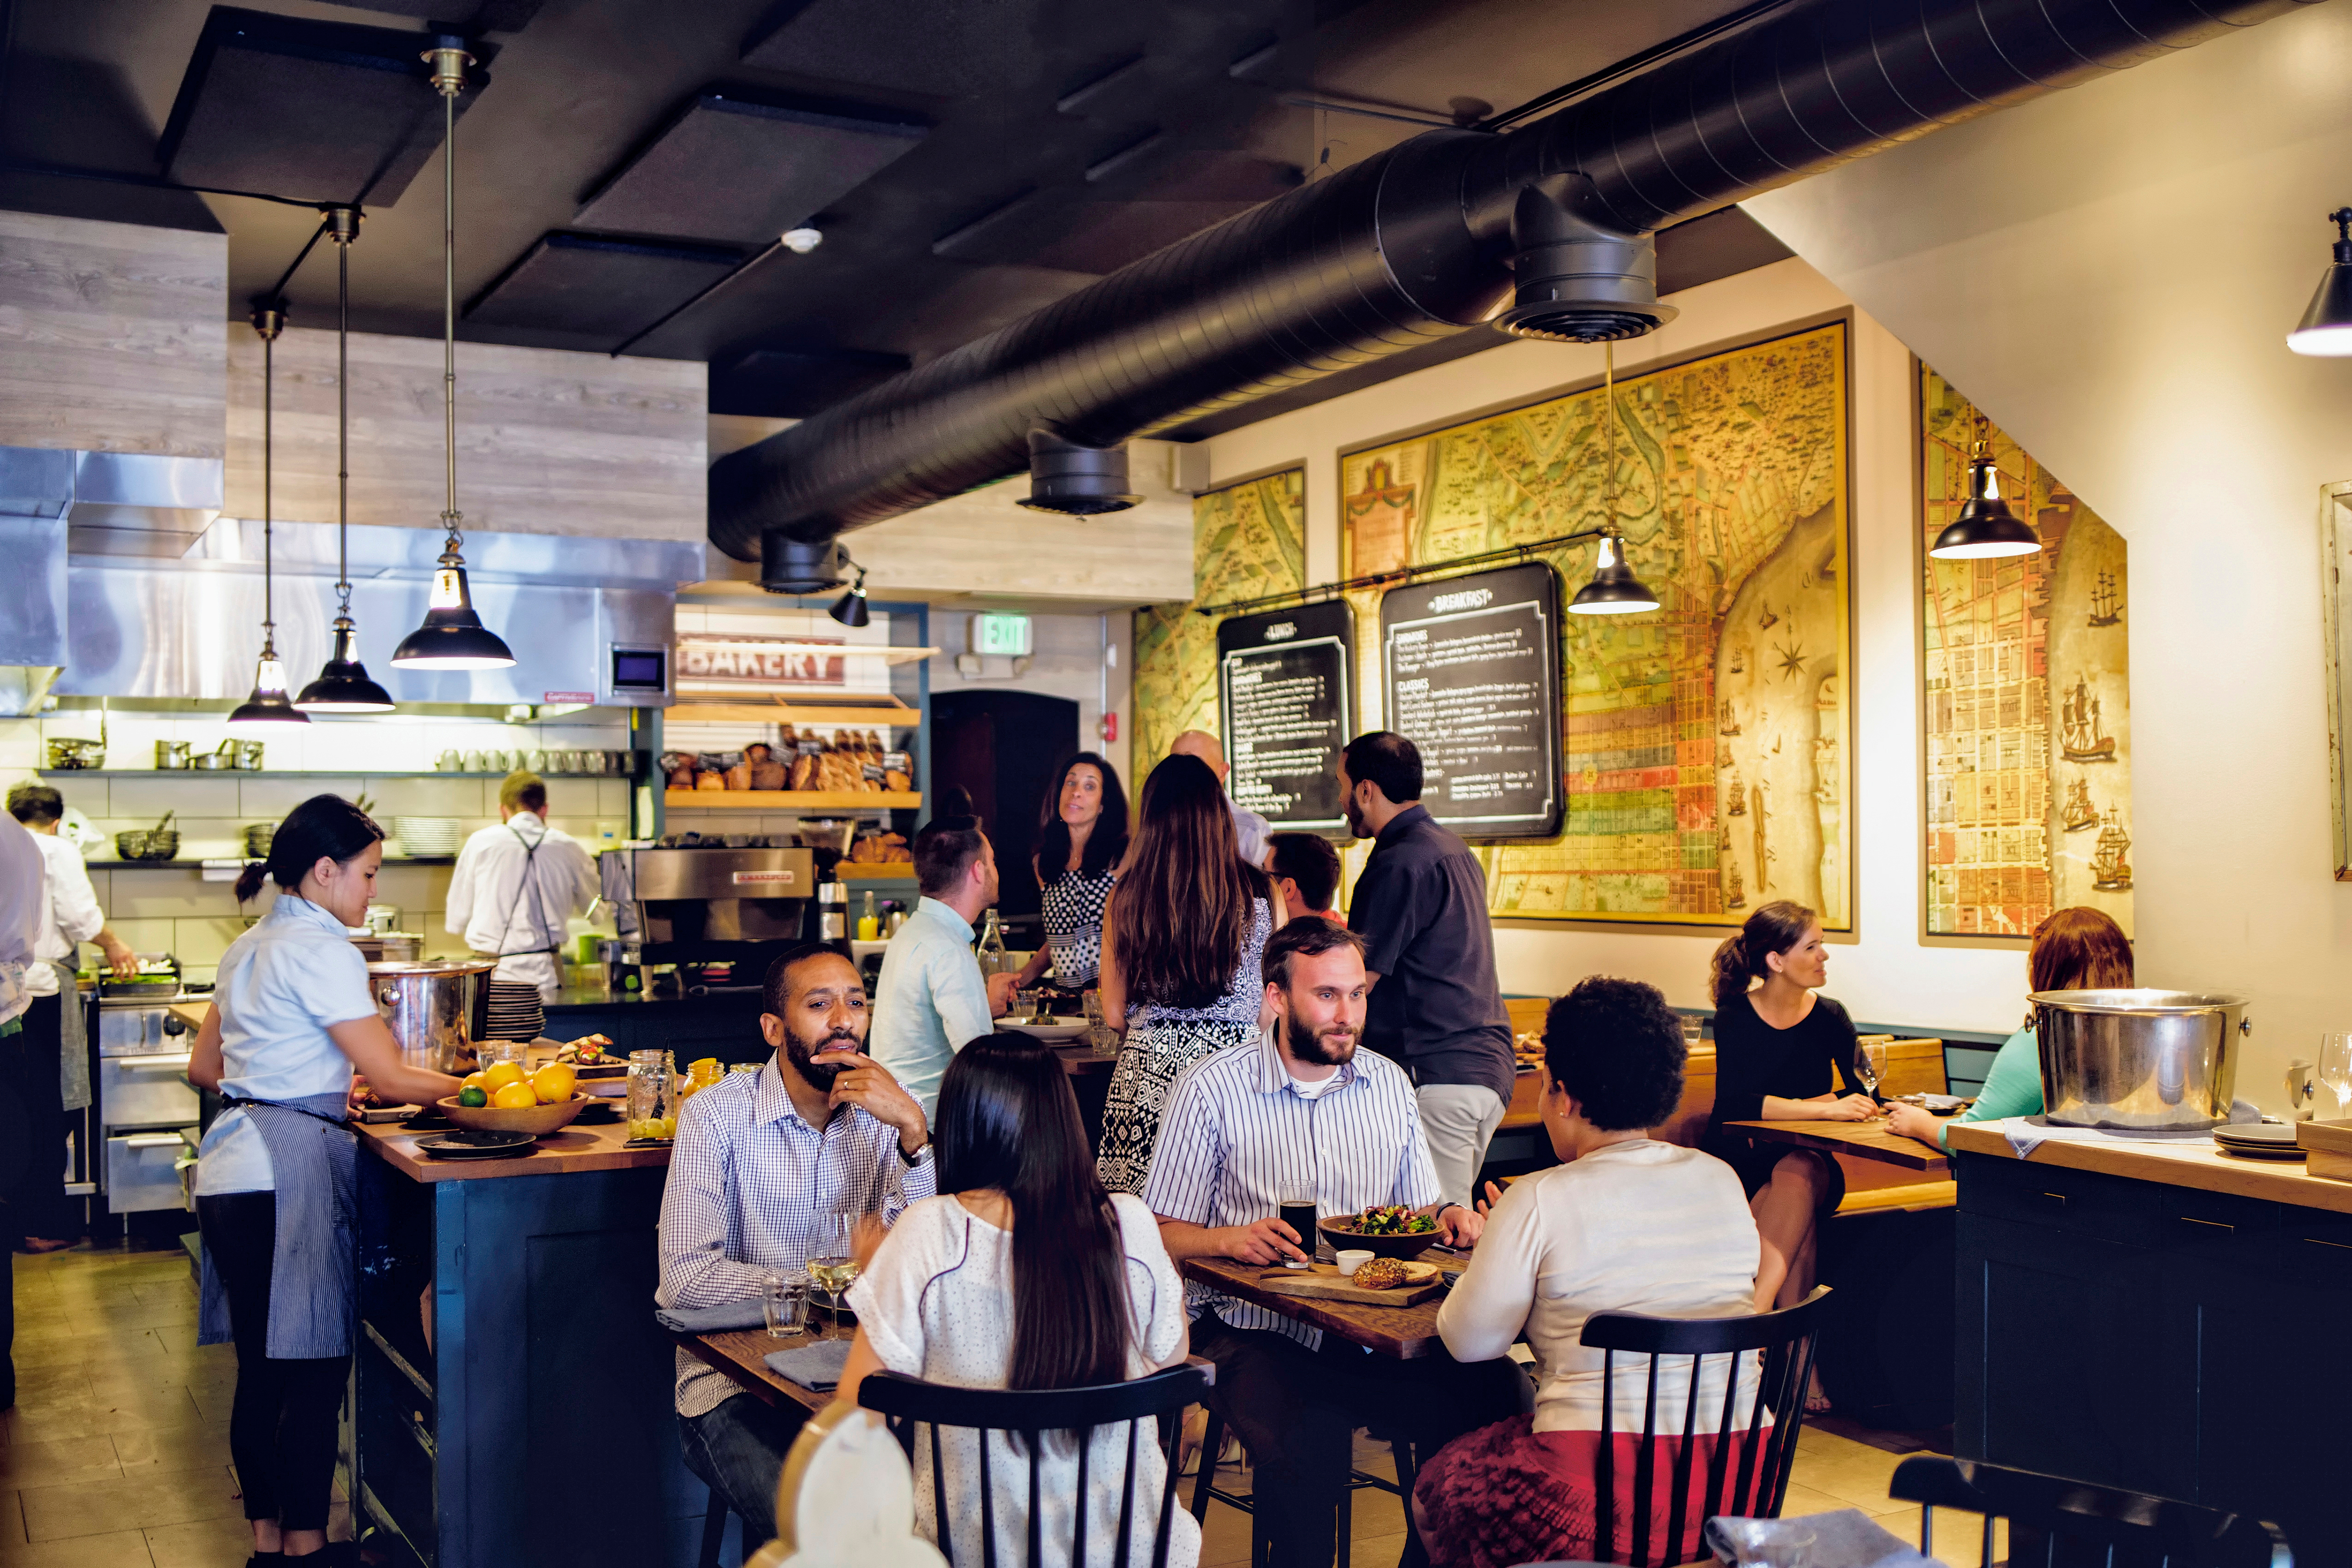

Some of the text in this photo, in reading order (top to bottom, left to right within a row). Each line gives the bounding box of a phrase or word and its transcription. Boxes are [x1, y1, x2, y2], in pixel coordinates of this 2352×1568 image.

[1433, 588, 1489, 613] BREAKFAST
[983, 615, 1027, 654] EXIT
[1268, 622, 1294, 641] LUNCH
[686, 638, 837, 679] BAKERY
[1396, 677, 1429, 692] CLASSICS
